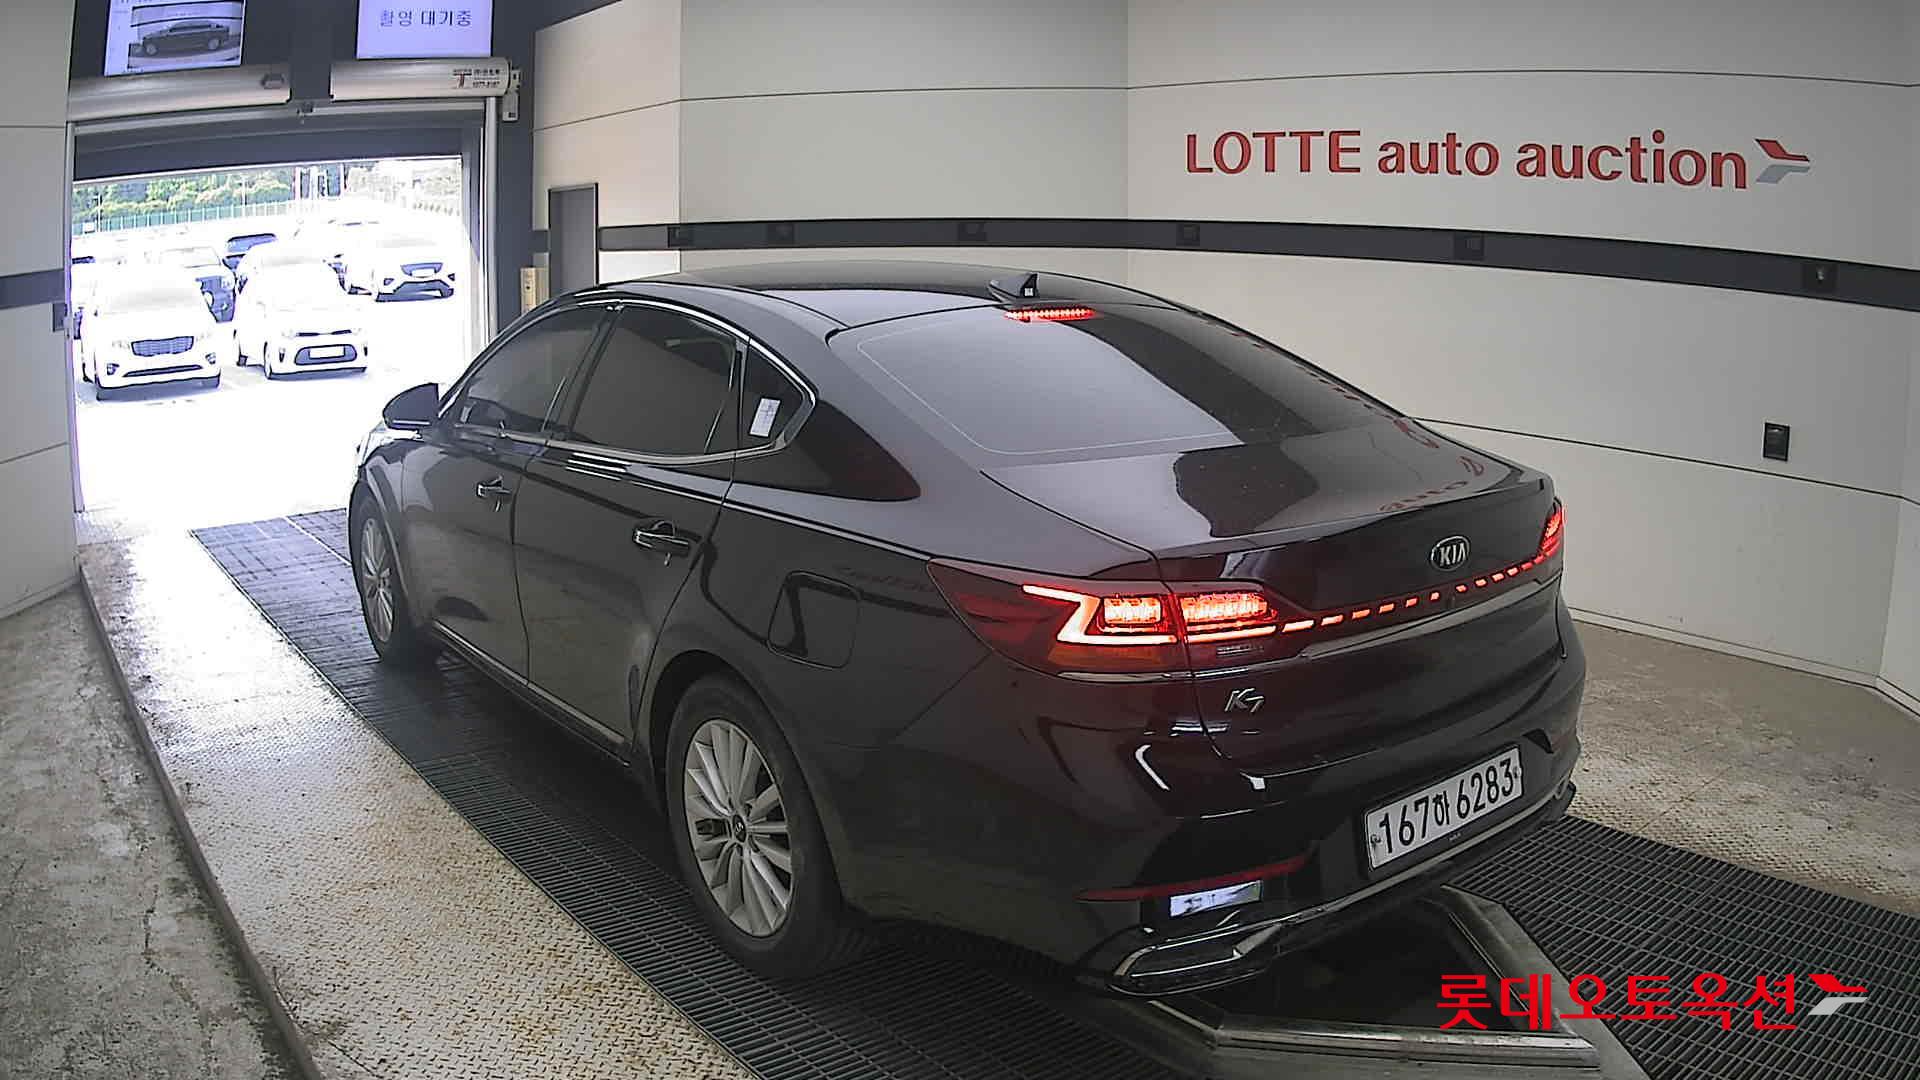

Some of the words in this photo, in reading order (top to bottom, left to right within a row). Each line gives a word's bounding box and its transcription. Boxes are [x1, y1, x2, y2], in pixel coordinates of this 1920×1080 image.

[421, 10, 472, 27] 대기중
[1186, 130, 1361, 173] LOTTE
[1378, 133, 1499, 176] auto
[1516, 130, 1747, 189] auction
[1439, 541, 1466, 567] KIA
[1224, 687, 1265, 713] K7
[1379, 790, 1450, 853] 167하
[1457, 758, 1514, 819] 6283
